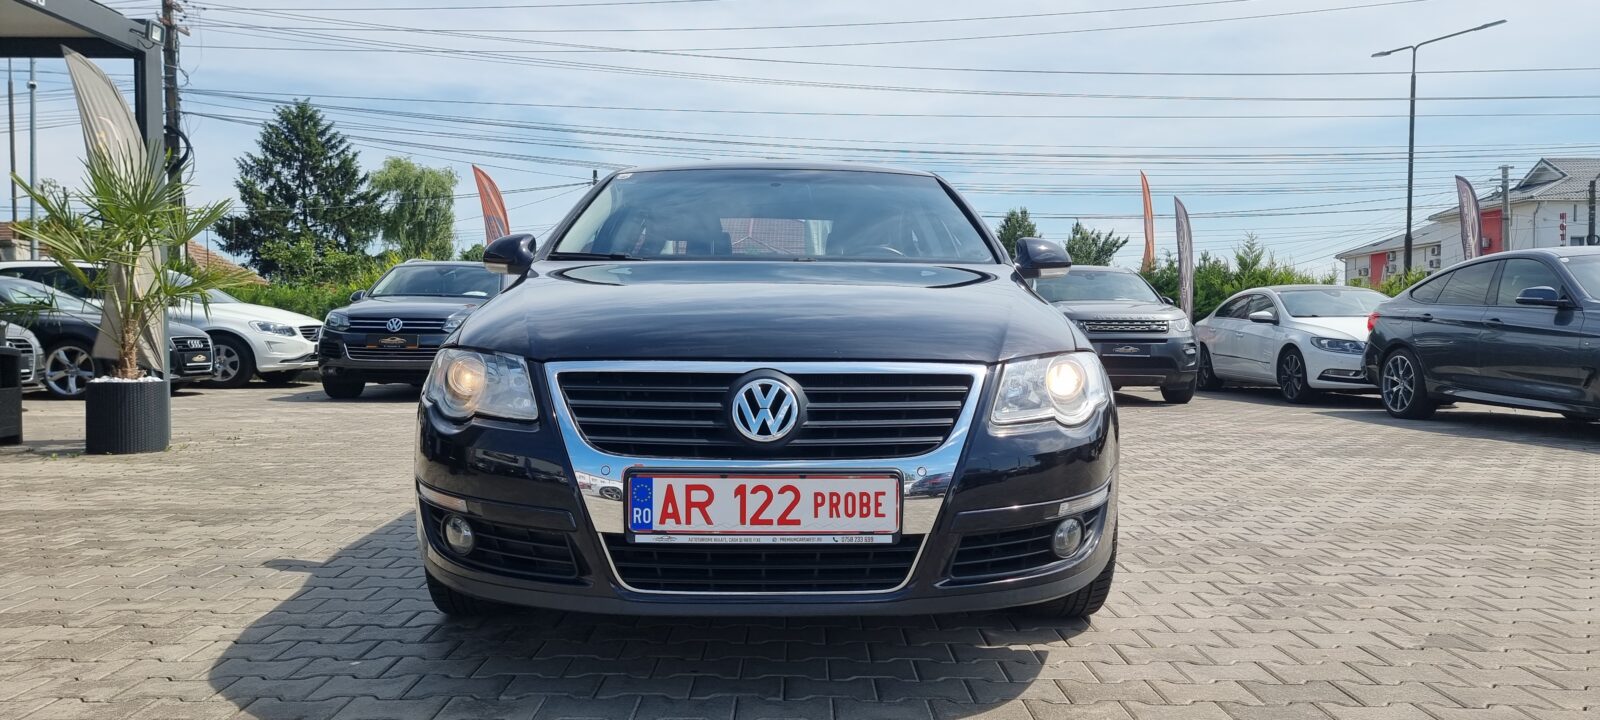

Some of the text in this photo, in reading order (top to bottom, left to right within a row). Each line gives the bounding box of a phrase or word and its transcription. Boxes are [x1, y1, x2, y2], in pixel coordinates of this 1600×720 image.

[633, 507, 651, 524] RO
[658, 484, 886, 526] AR 122 PROBE
